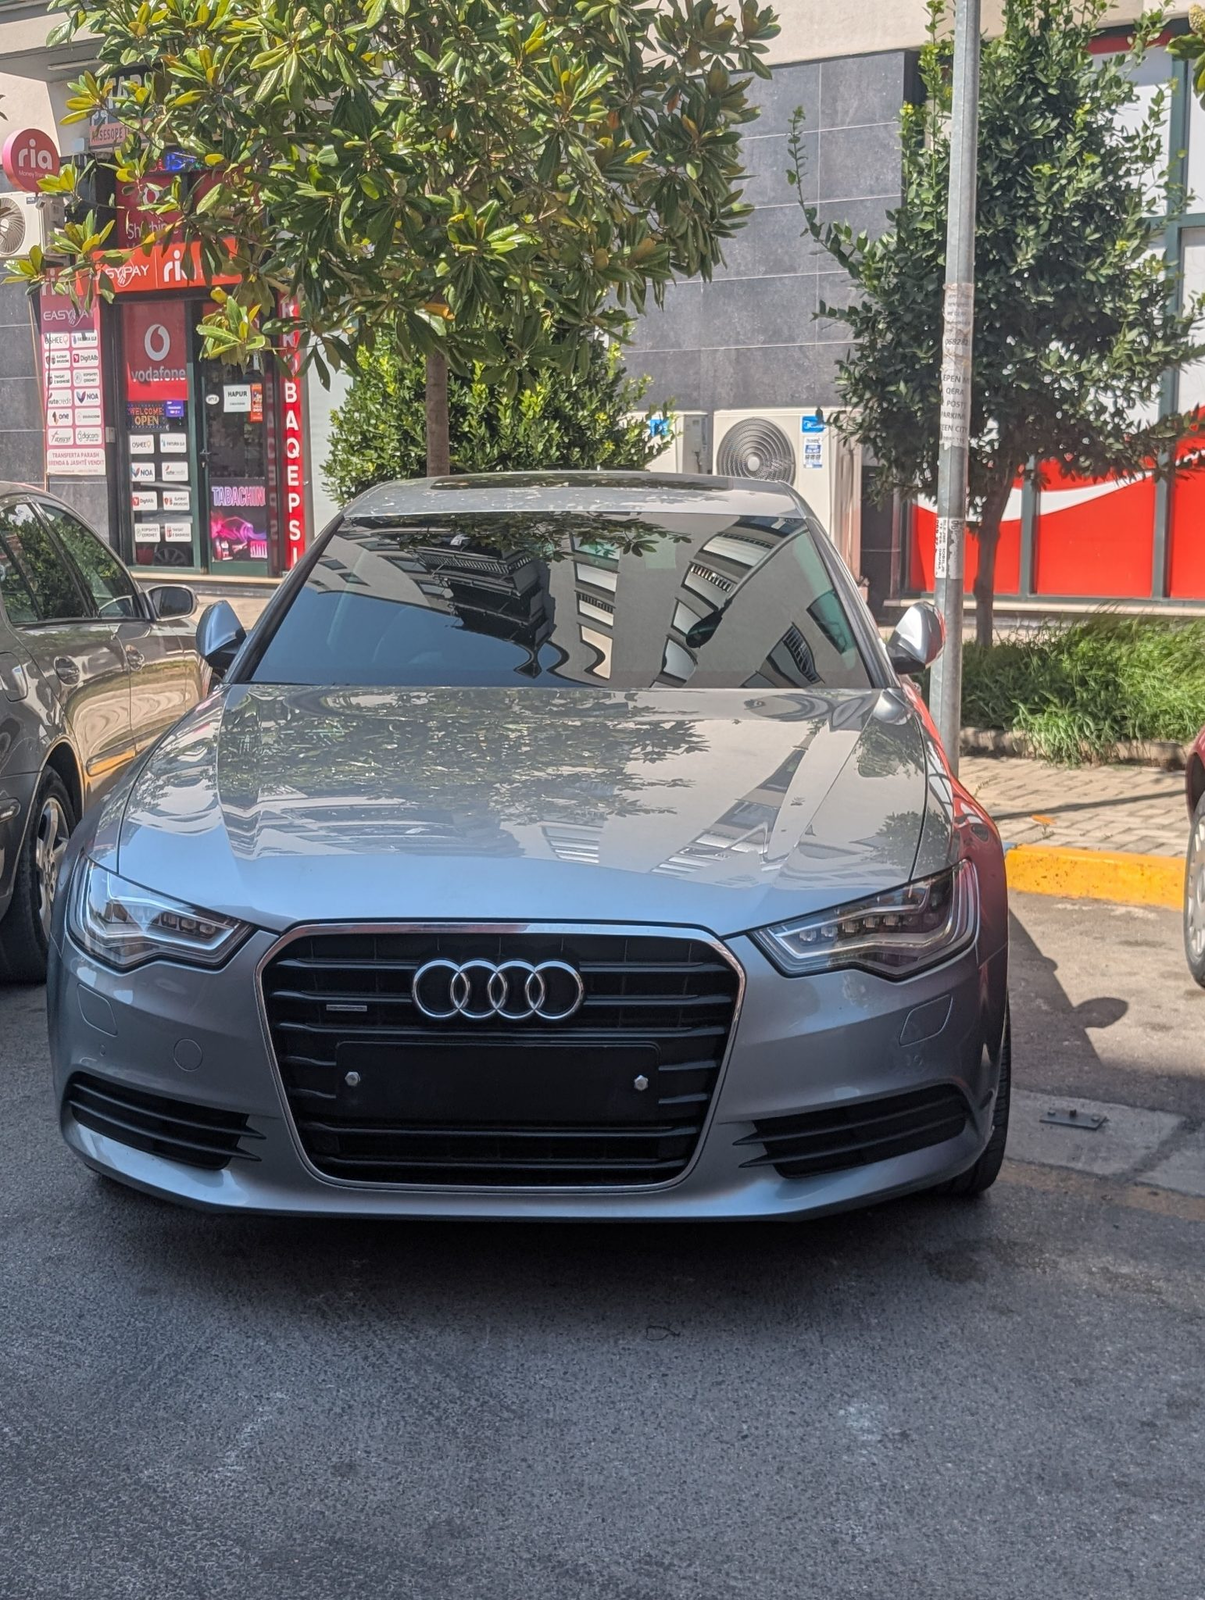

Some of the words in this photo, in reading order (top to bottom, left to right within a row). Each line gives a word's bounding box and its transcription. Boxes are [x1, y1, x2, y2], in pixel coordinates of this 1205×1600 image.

[91, 127, 123, 141] SESORE
[18, 138, 53, 169] ria
[97, 264, 149, 282] SYPAY
[43, 310, 94, 322] EASYAY
[131, 366, 186, 382] vodafone
[943, 374, 961, 383] EPEN
[134, 415, 160, 426] OPEN
[140, 469, 153, 477] NOA
[211, 486, 266, 507] TABACHIN
